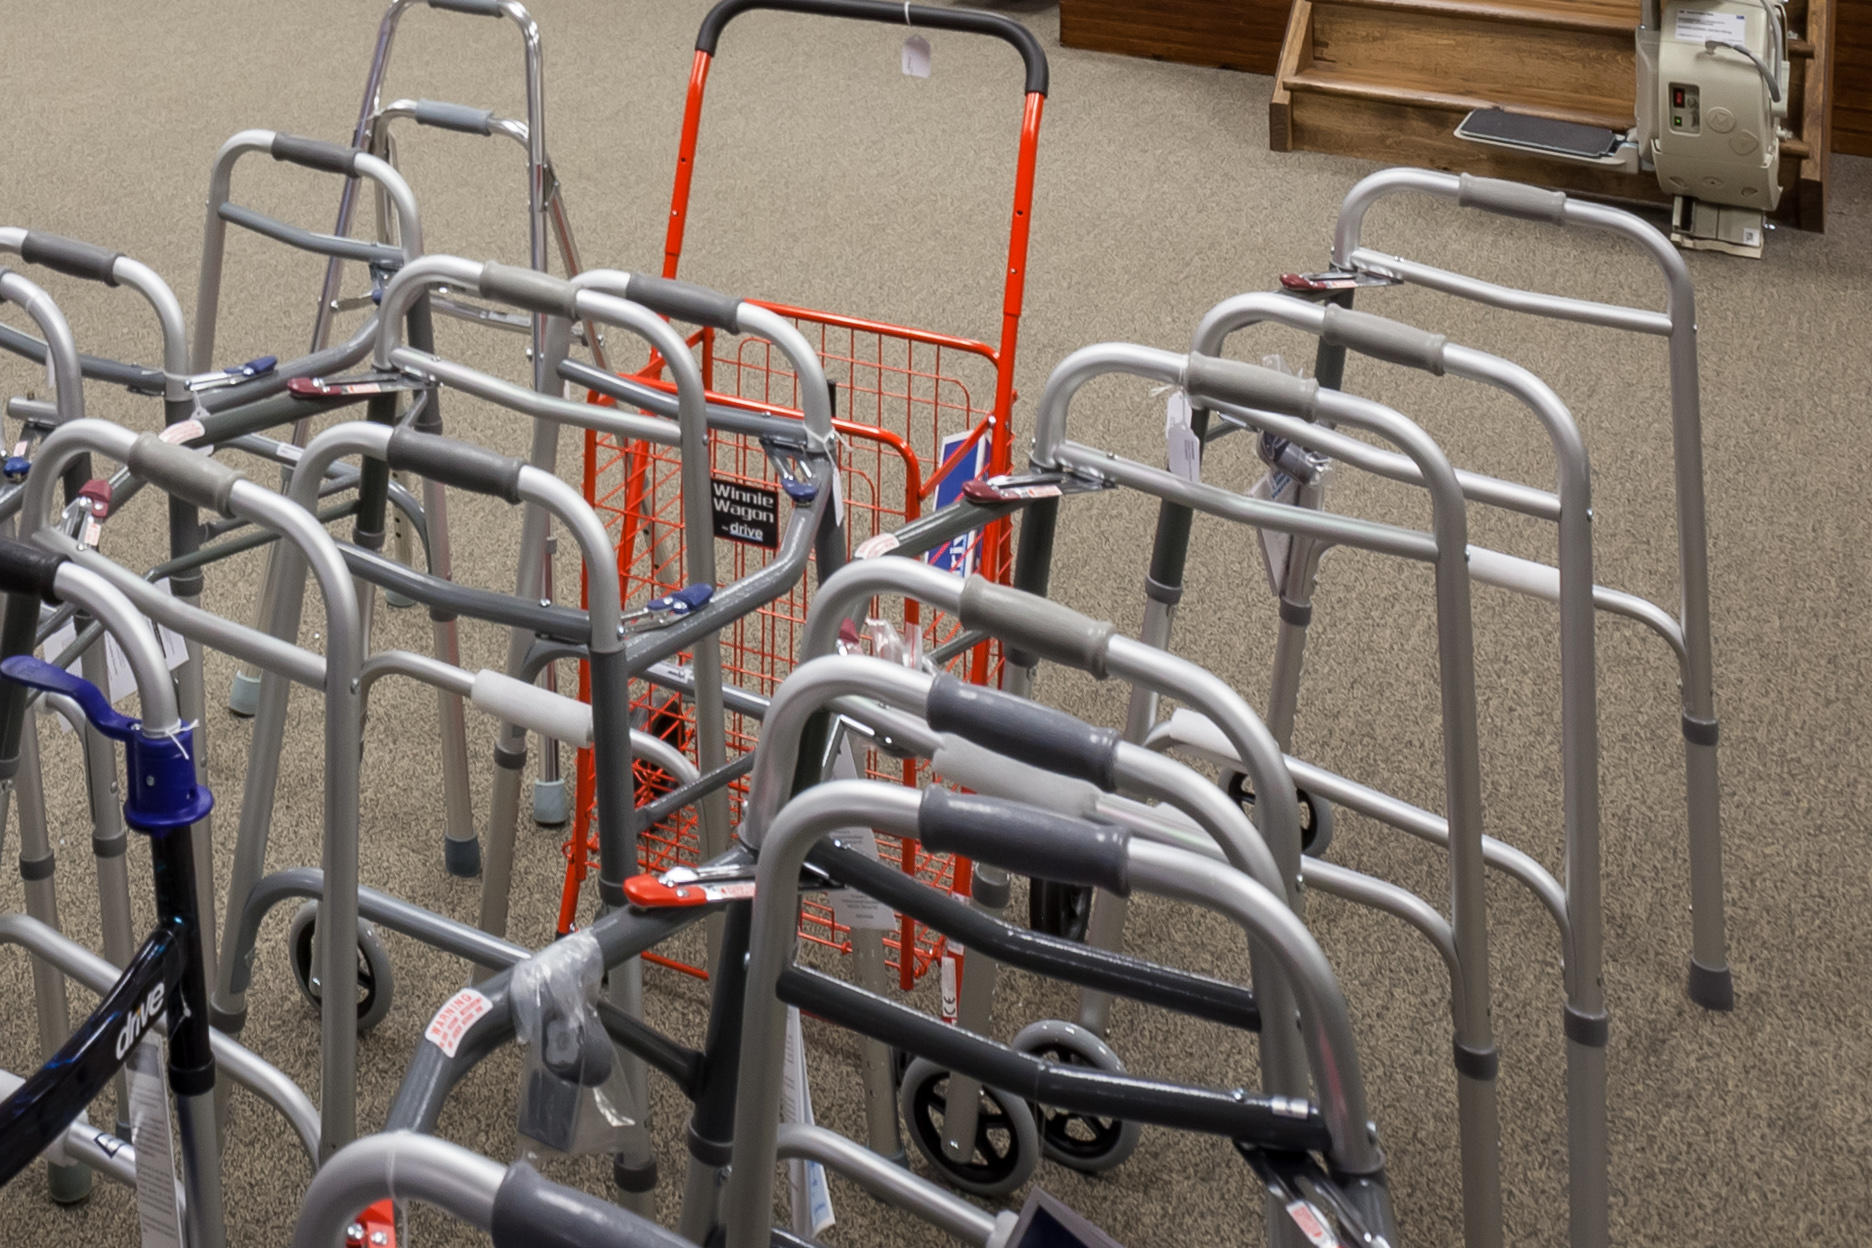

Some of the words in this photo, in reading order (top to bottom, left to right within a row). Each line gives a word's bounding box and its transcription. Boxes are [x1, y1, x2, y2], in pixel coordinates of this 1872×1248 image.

[713, 482, 774, 509] Winnie
[713, 497, 774, 523] Wagon
[729, 522, 763, 540] drive
[116, 982, 165, 1061] drive
